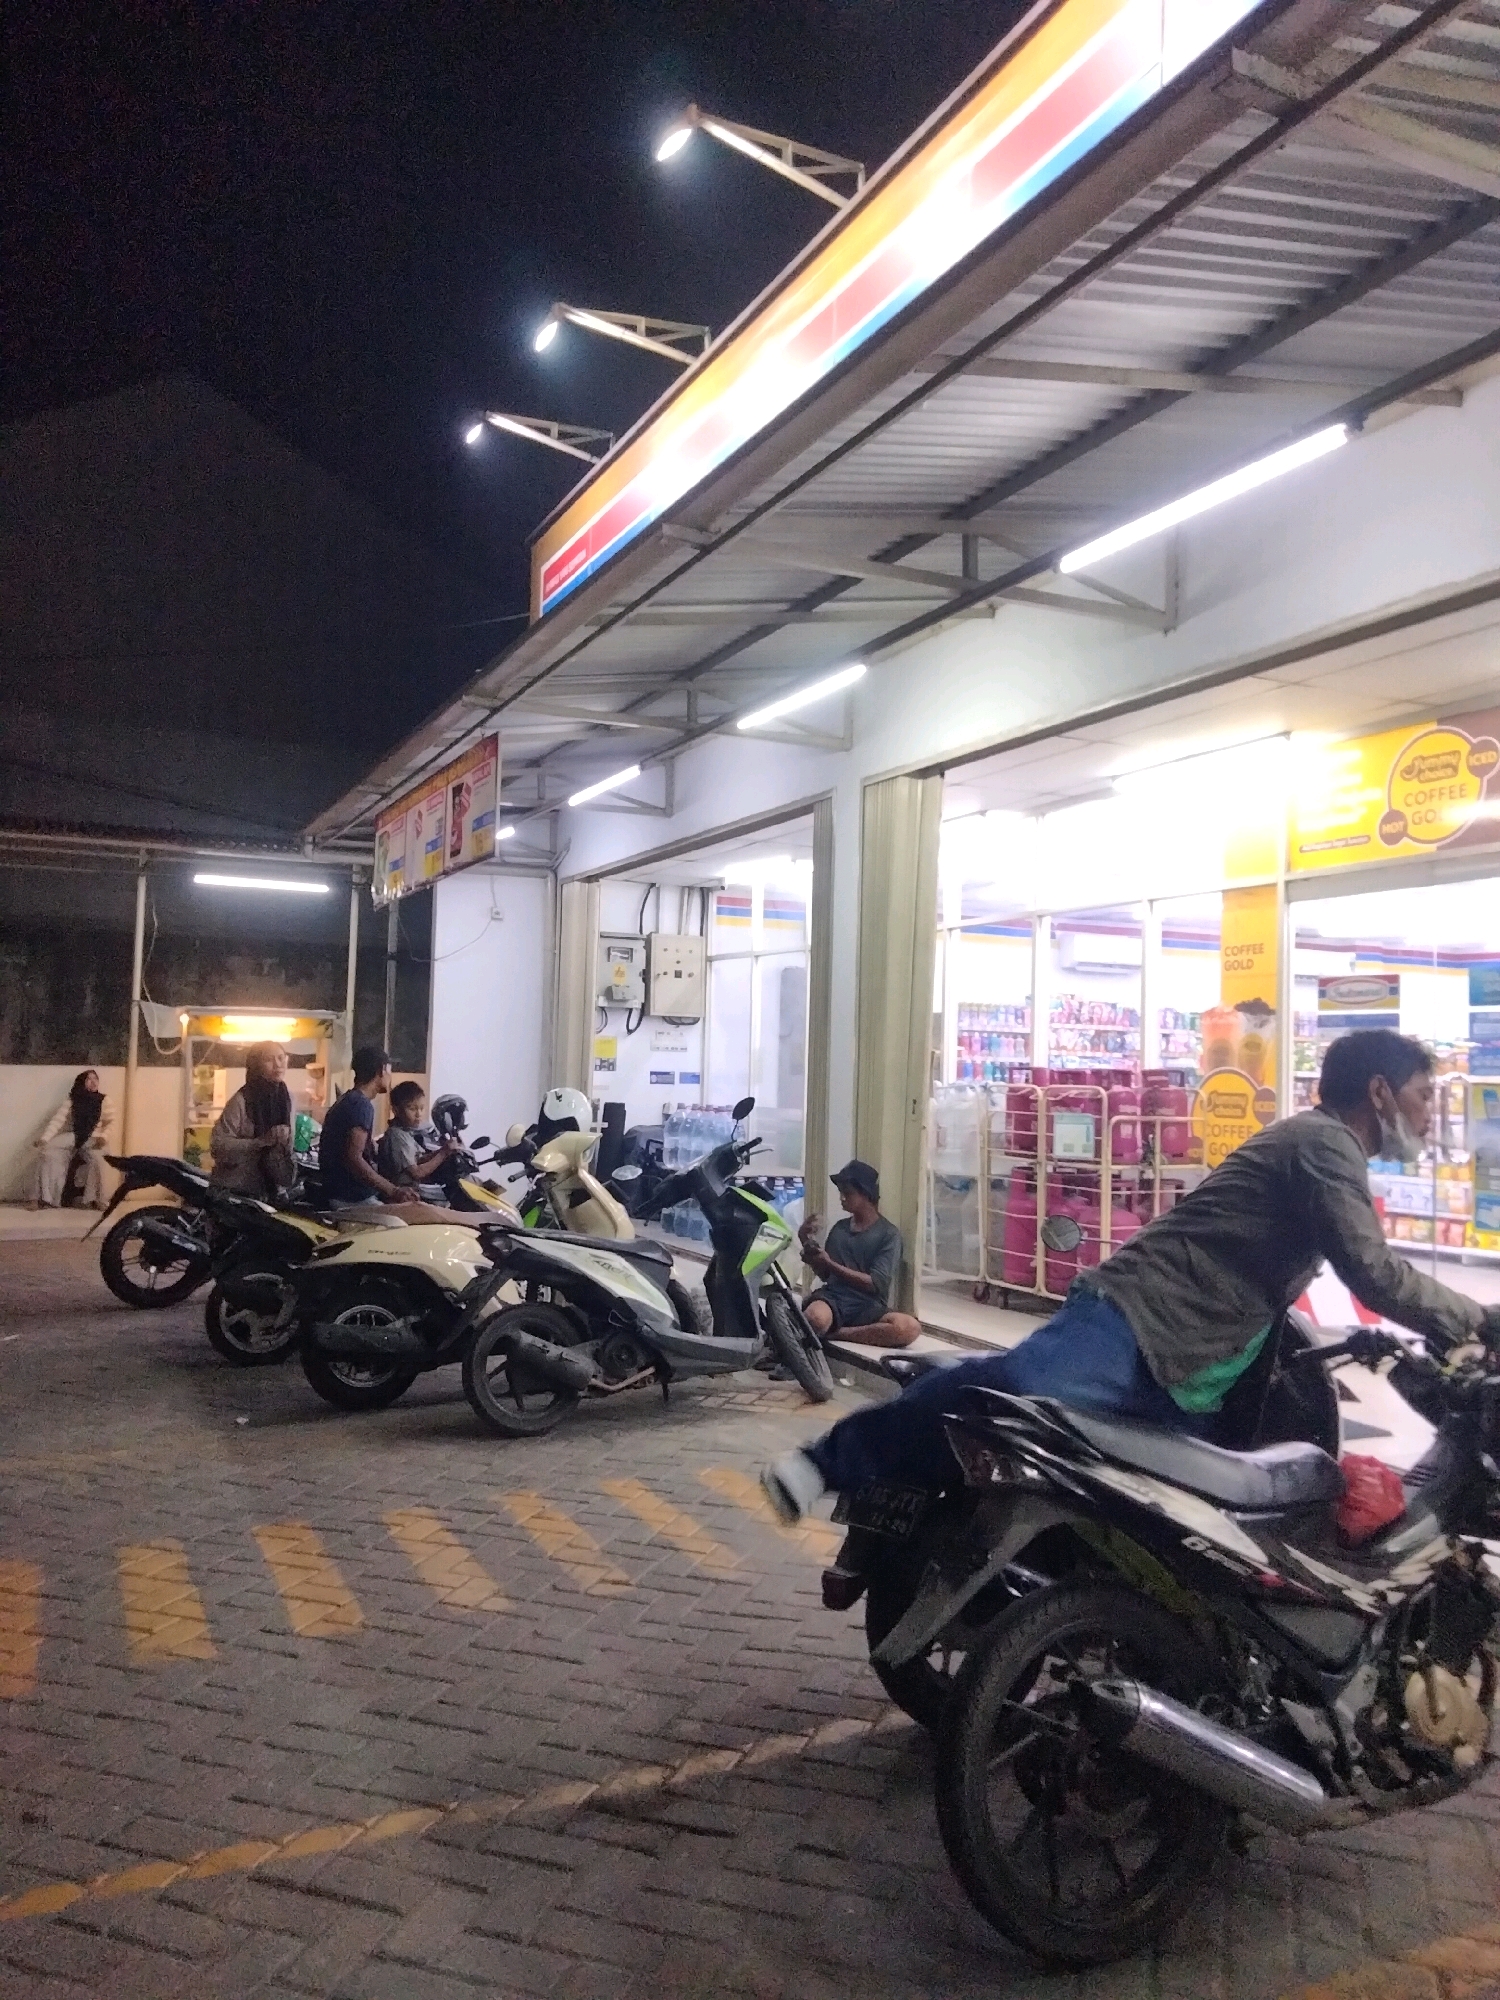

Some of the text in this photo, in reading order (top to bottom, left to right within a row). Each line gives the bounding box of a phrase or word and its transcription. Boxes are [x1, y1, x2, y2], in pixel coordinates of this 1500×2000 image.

[1468, 751, 1498, 766] ICED
[1404, 783, 1467, 808] COFFEE
[1381, 821, 1405, 835] HOT
[1224, 943, 1264, 957] COFFEE
[1224, 959, 1254, 972] GOLD
